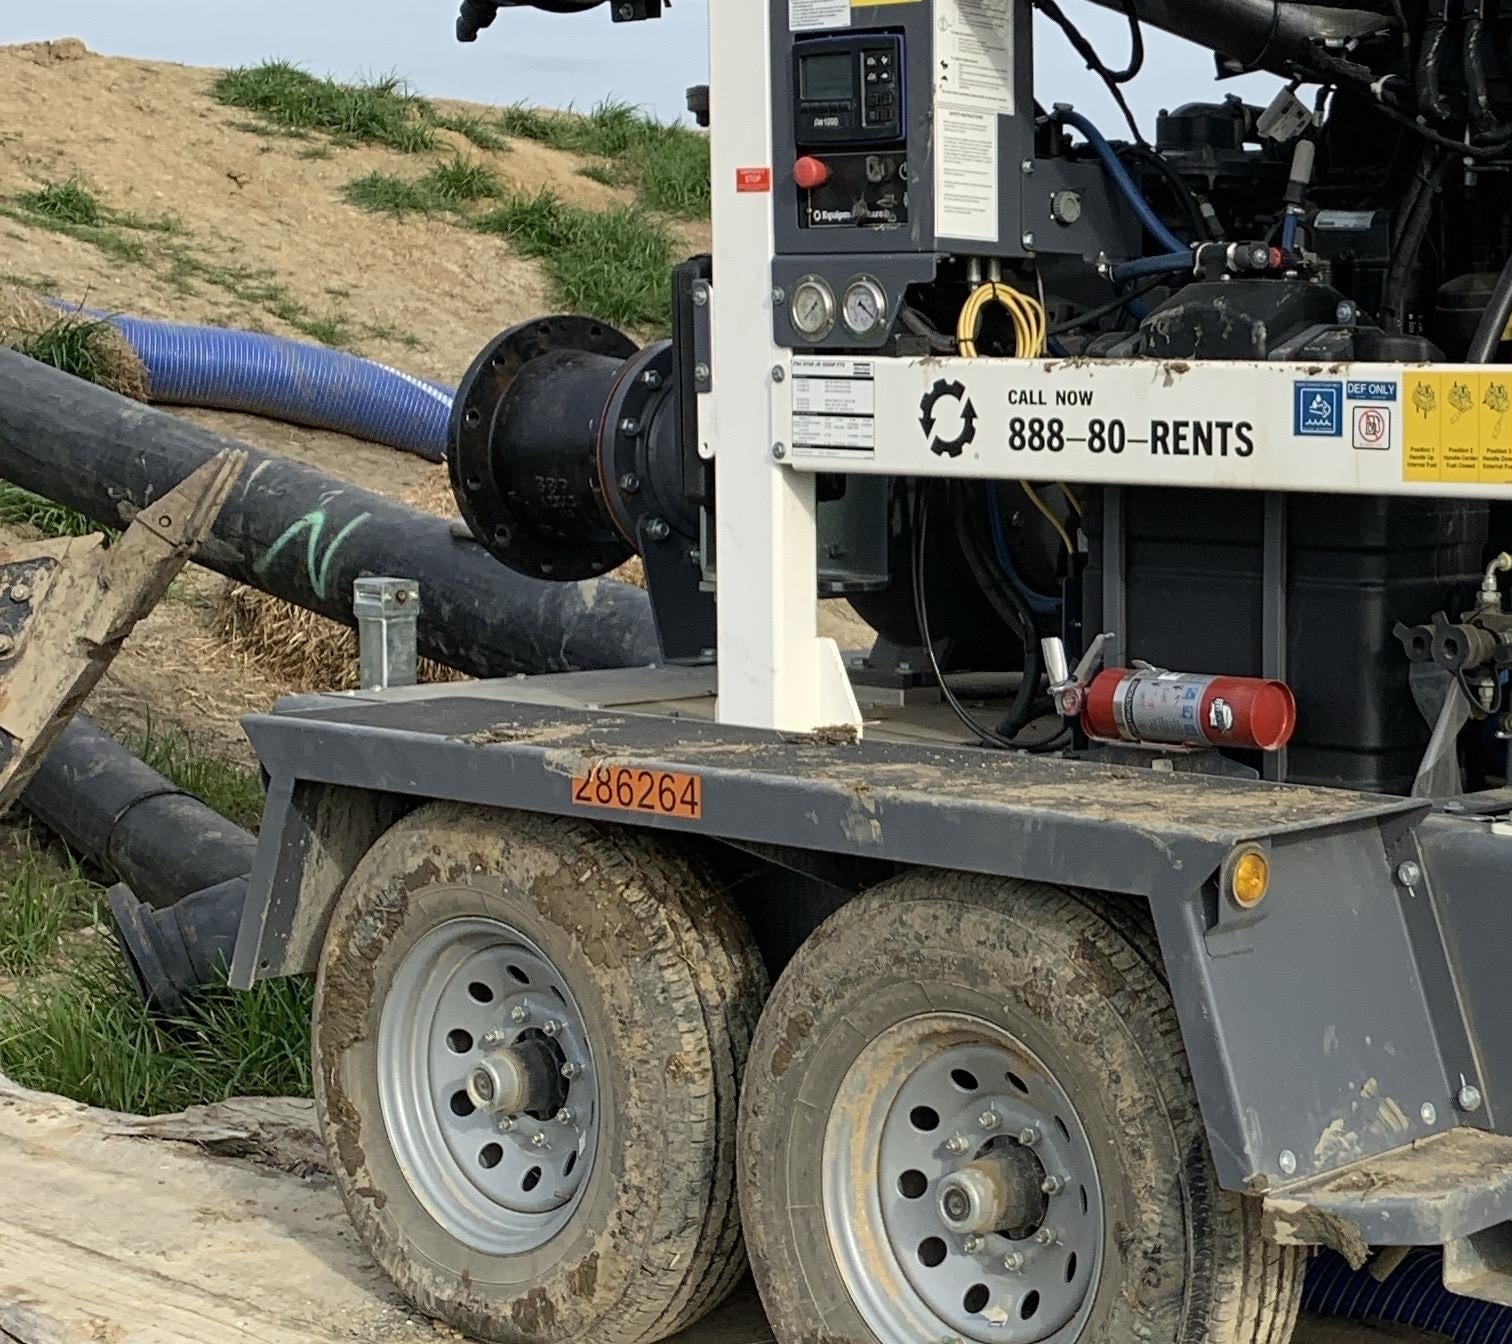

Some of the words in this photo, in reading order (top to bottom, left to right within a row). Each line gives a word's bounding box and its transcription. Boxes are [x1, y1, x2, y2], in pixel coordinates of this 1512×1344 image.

[1347, 382, 1367, 394] DEF
[1368, 383, 1395, 395] ONLY
[1007, 389, 1047, 406] CALL
[1056, 390, 1093, 406] NOW
[575, 767, 699, 815] 286264
